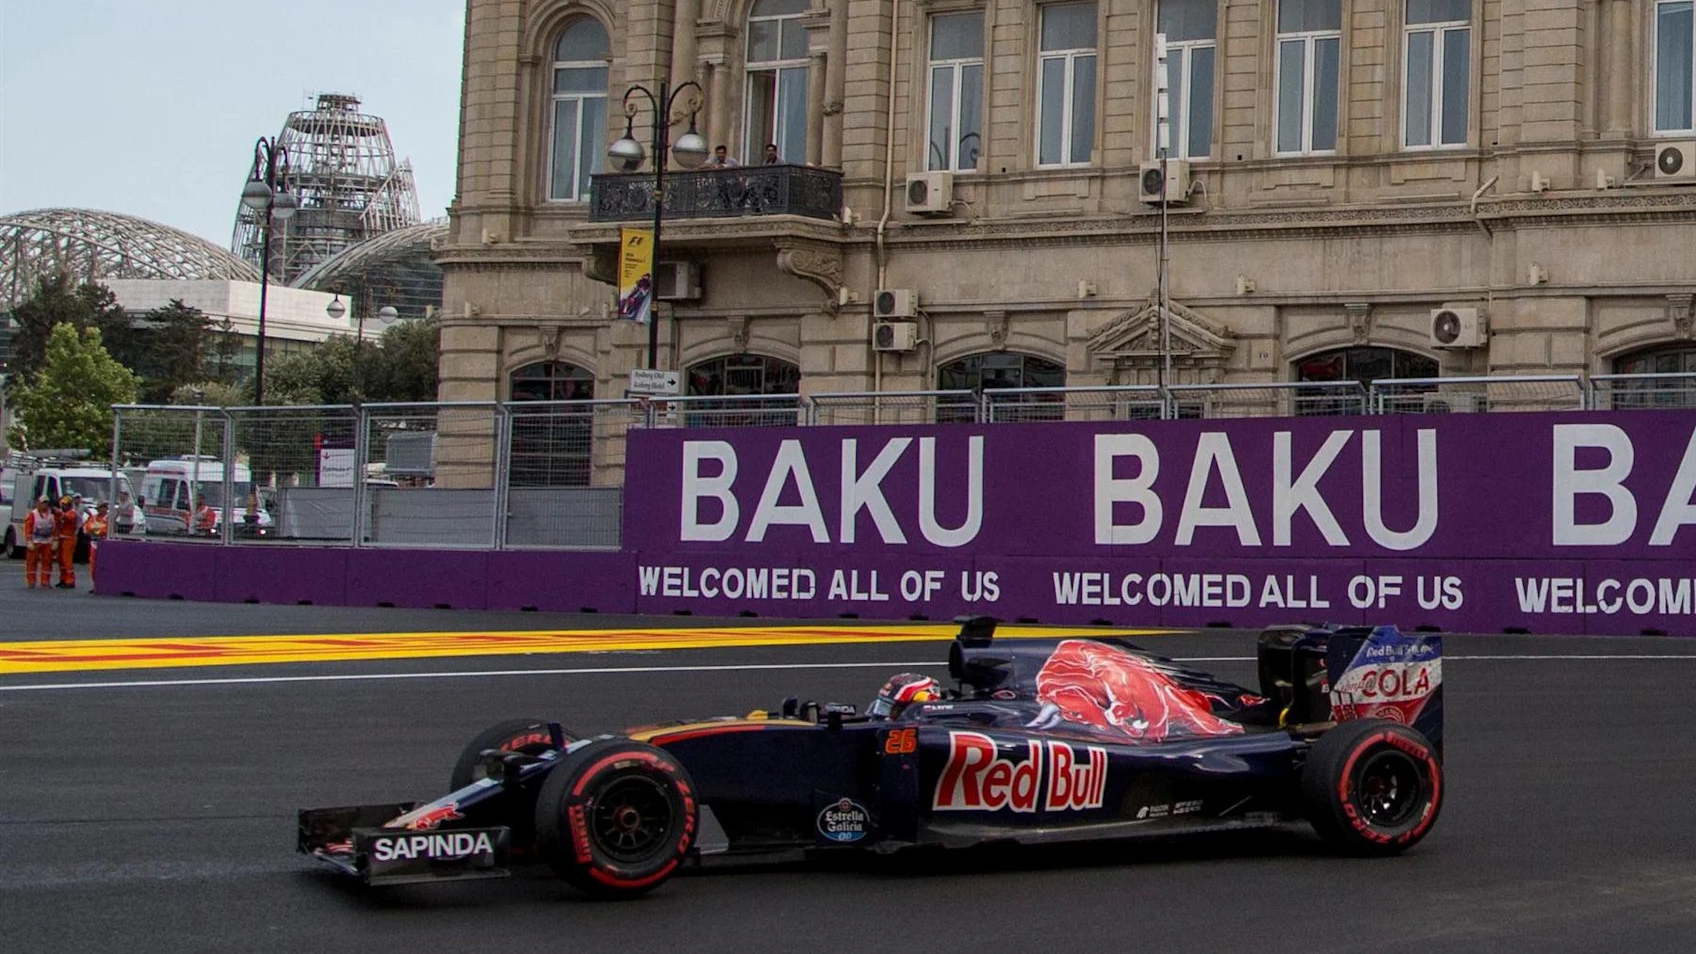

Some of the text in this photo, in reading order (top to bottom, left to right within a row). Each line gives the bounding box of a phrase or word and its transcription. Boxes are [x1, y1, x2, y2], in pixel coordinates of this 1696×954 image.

[681, 436, 984, 548] BAKU
[1095, 429, 1439, 551] BAKU
[639, 566, 1000, 603] WELCOMED ALL OF US
[1053, 572, 1464, 610] WELCOMED ALL OF US
[1362, 667, 1430, 698] COLA
[885, 728, 918, 755] 26
[933, 731, 1108, 813] Red Bull
[825, 810, 864, 822] Estrella
[827, 821, 863, 833] Galicia
[374, 831, 494, 861] SAPINDA
